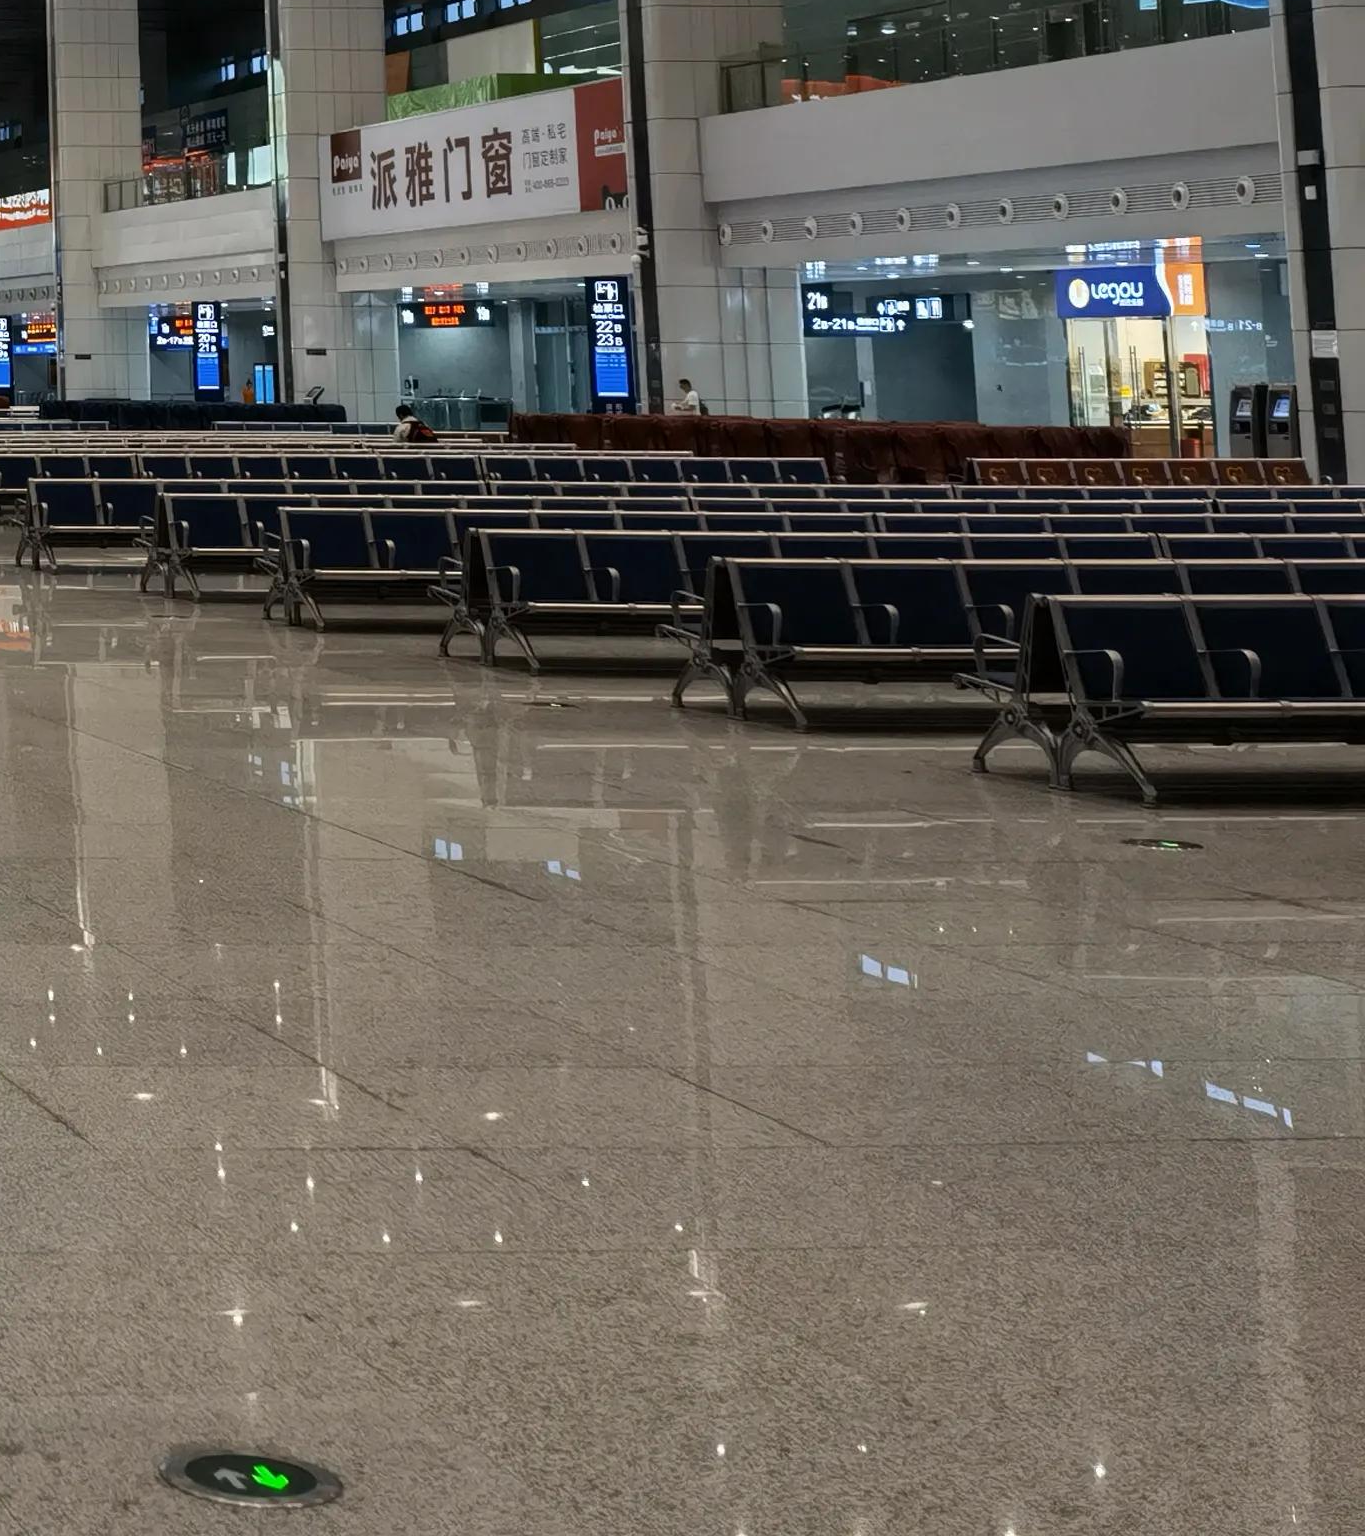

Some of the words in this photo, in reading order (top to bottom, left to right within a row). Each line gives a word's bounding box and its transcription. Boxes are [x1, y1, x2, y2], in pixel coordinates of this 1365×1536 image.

[370, 128, 512, 210] 派雅门窗
[593, 304, 623, 313] 检票口
[596, 321, 622, 333] 22B
[597, 334, 623, 345] 23B
